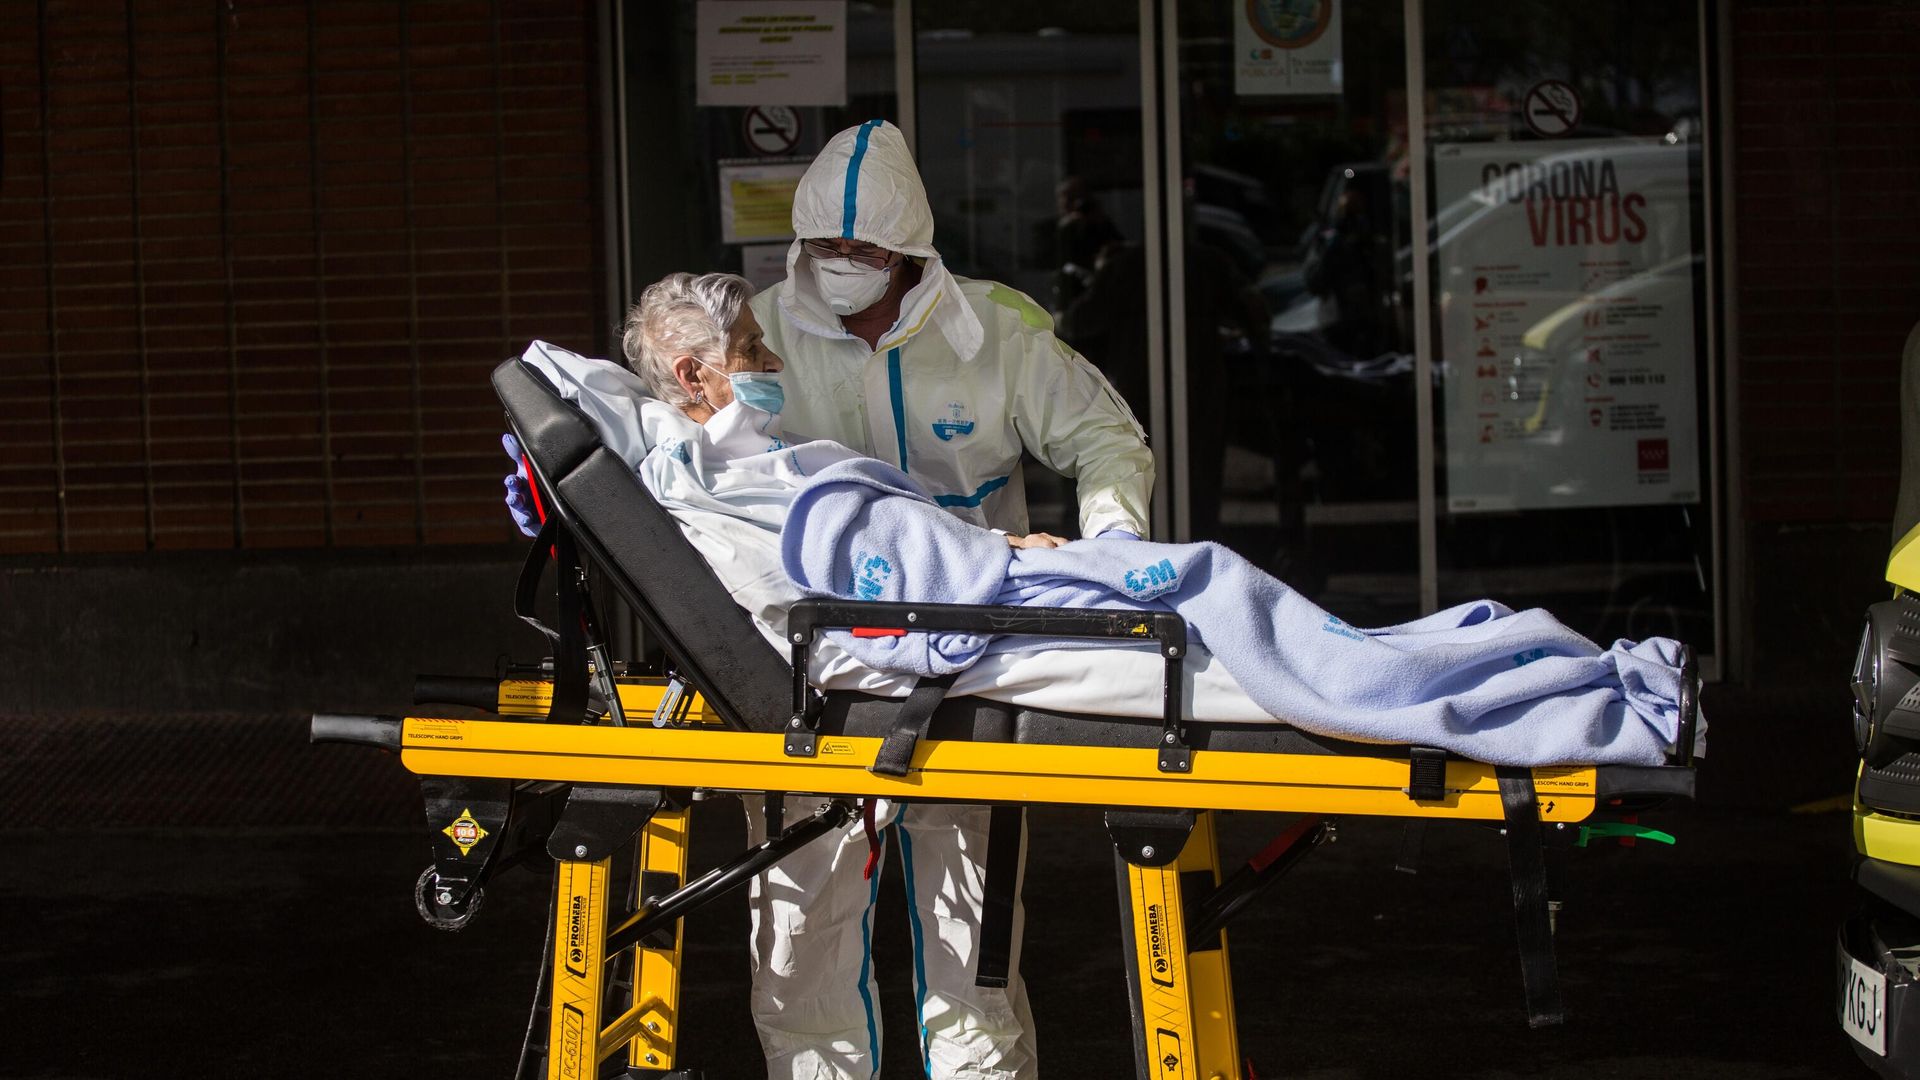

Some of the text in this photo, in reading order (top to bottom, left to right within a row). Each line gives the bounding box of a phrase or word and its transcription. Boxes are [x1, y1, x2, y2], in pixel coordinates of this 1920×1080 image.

[1482, 159, 1620, 203] CORONA
[1524, 192, 1647, 247] VIRUS
[570, 895, 580, 947] PROMEBA
[1148, 904, 1160, 957] PROMEBA
[1849, 969, 1876, 1036] KGJ
